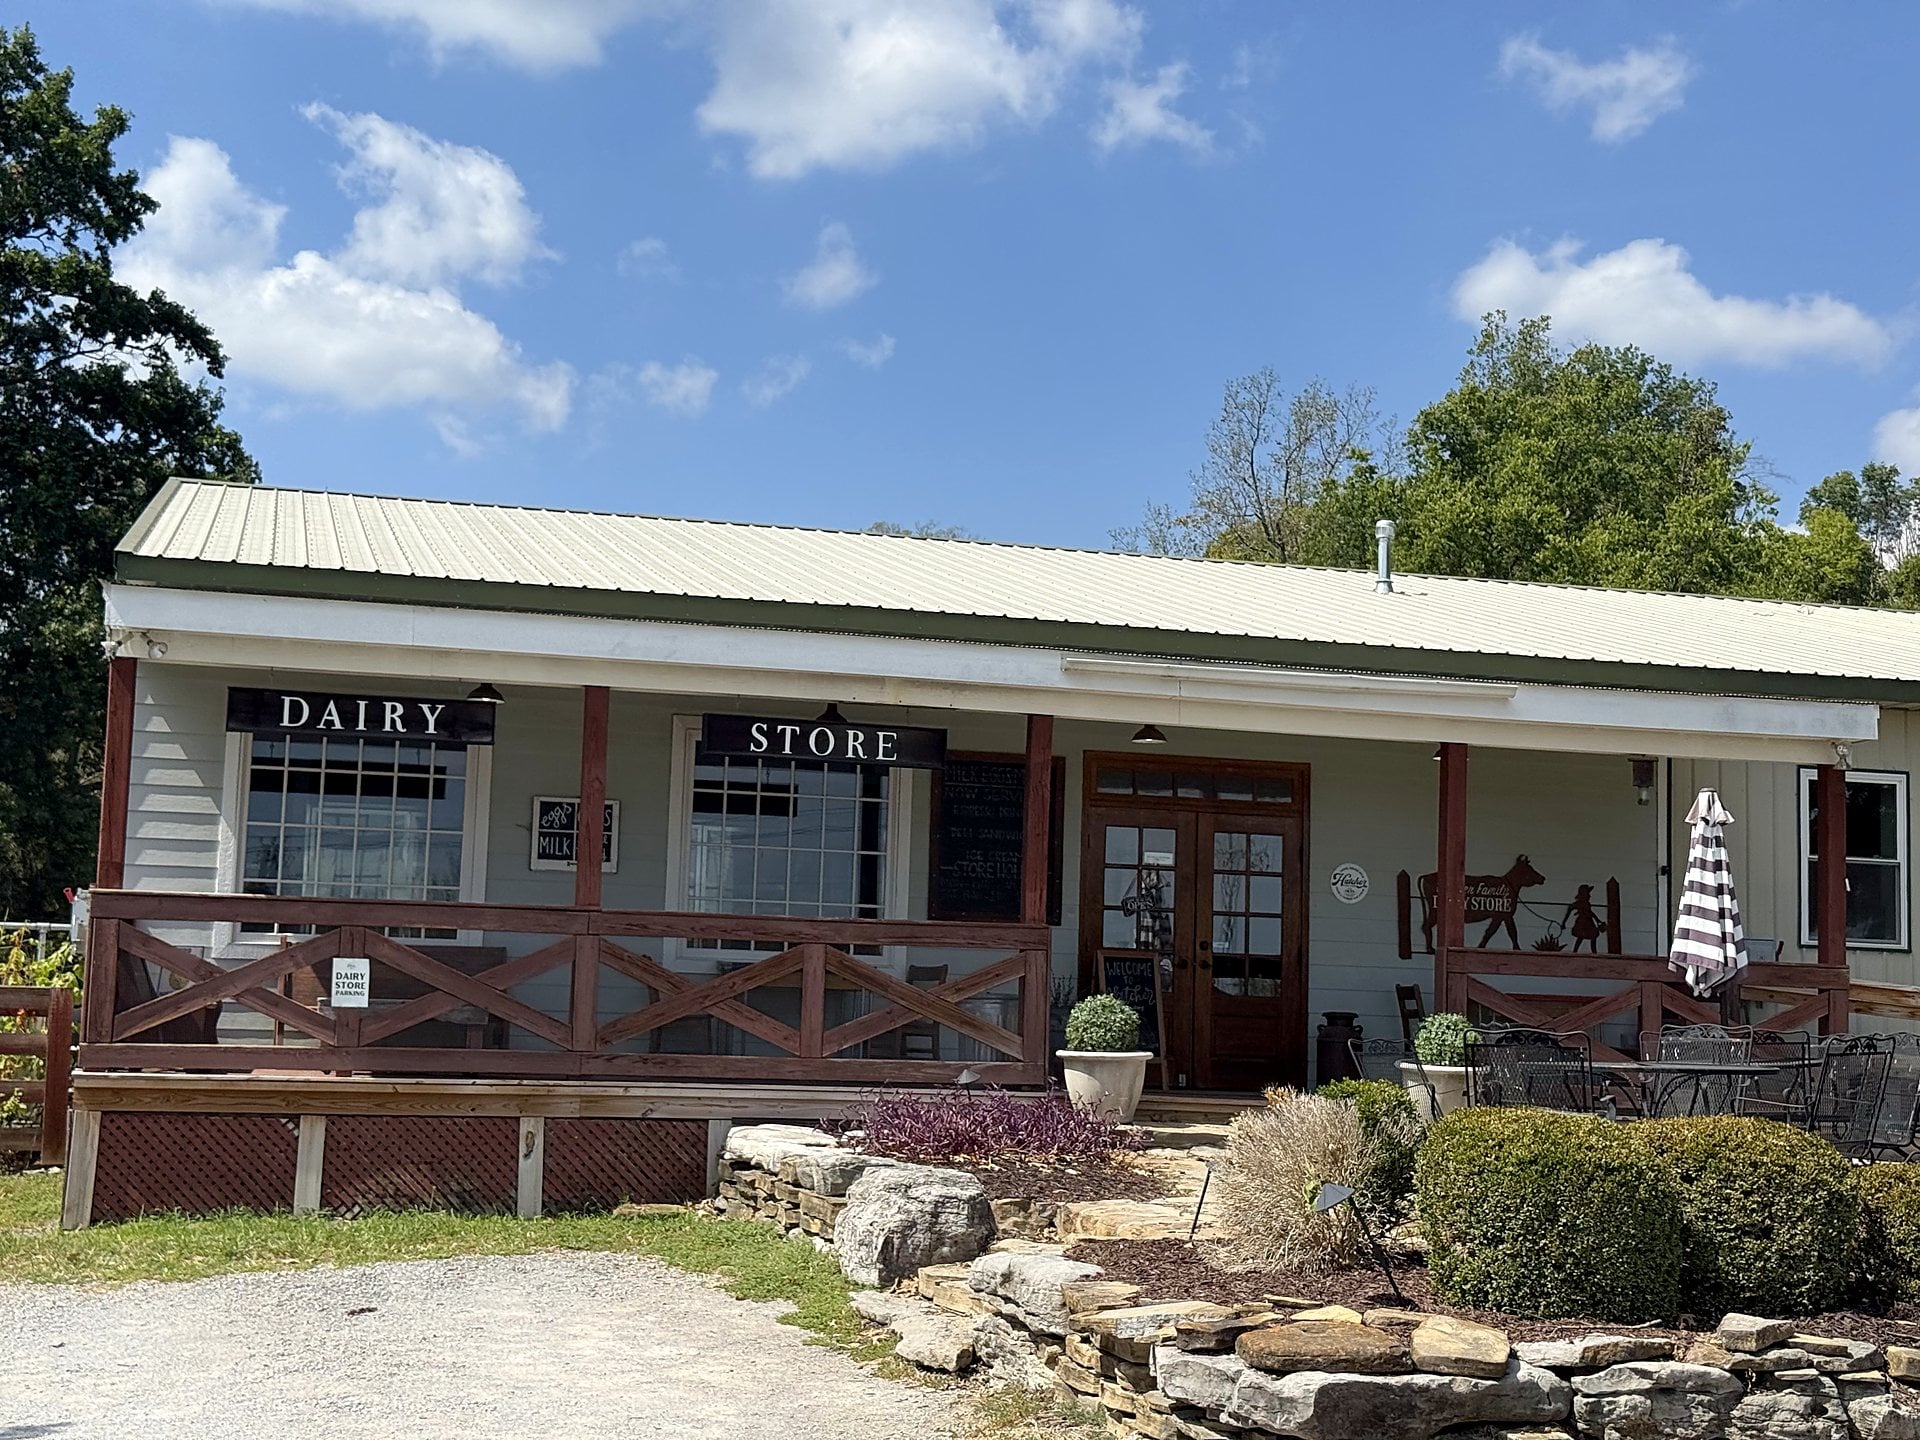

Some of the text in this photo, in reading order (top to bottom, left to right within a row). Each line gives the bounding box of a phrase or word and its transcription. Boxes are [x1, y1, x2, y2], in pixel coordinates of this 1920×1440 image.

[279, 695, 446, 735] DAIRY
[749, 722, 899, 761] STORE
[982, 788, 1024, 803] SERVI
[540, 803, 572, 829] eggs
[977, 828, 1024, 841] SANDWIC
[539, 836, 571, 856] MILK
[952, 861, 995, 879] STORE
[1476, 882, 1511, 898] Family
[1127, 900, 1154, 910] OPEN
[1471, 896, 1512, 912] STORE
[335, 971, 366, 981] DAIRY
[1105, 961, 1153, 977] WELCOME
[335, 981, 366, 990] STORE
